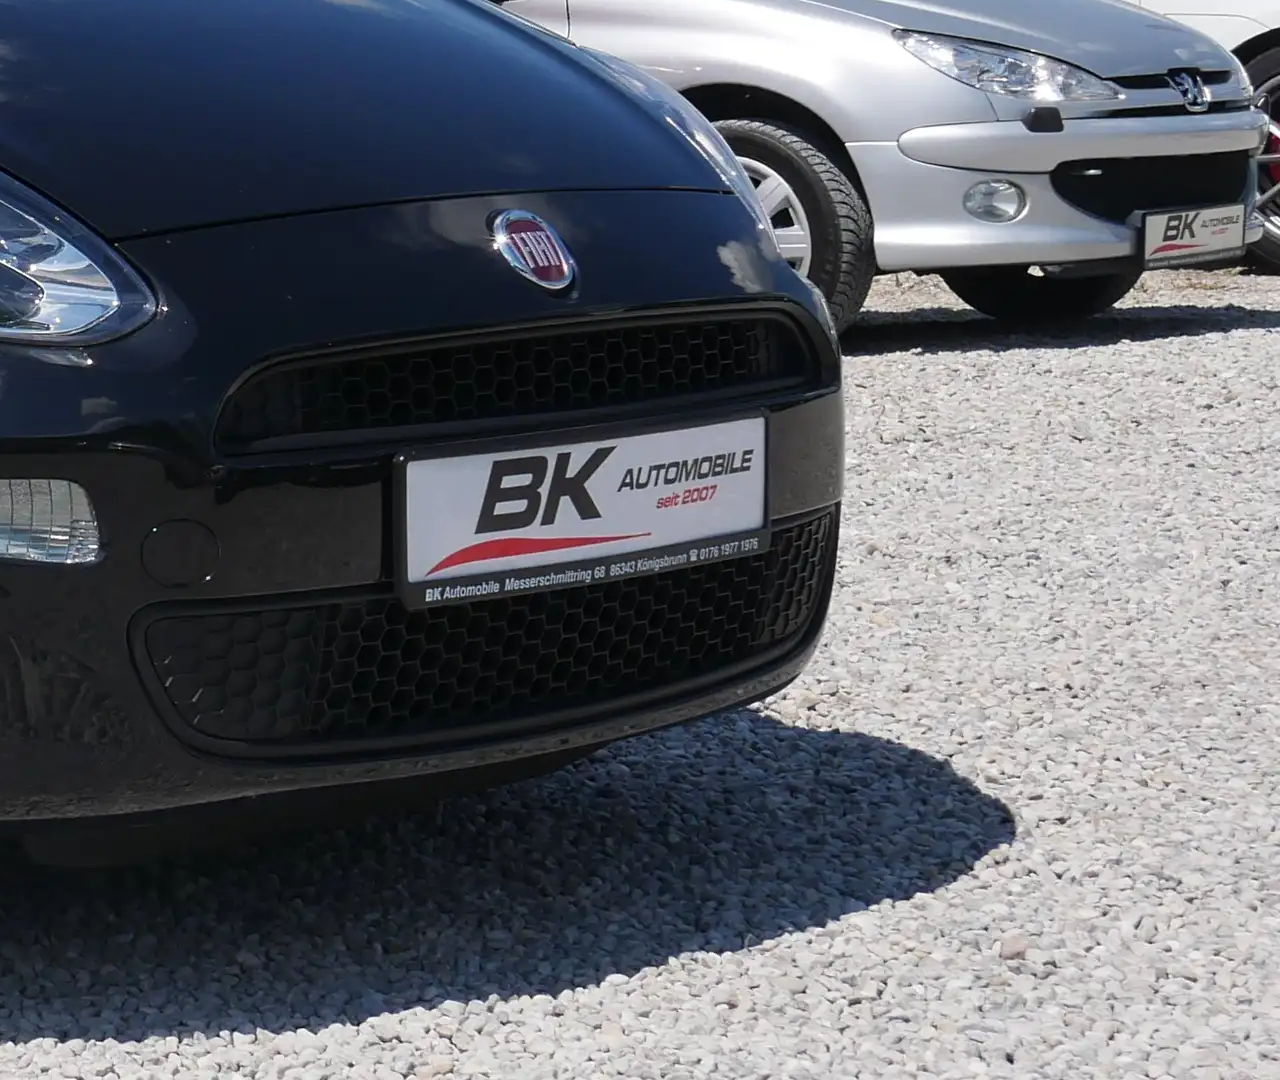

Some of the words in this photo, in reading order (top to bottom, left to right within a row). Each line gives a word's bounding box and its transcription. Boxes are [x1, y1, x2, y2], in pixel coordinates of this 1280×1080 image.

[1162, 212, 1200, 242] BK
[511, 231, 561, 268] FIAT
[474, 445, 618, 535] BK
[617, 449, 755, 493] AUTOMOBILE
[656, 491, 681, 509] seit
[681, 484, 718, 506] 2007
[425, 587, 443, 602] BK
[443, 581, 500, 599] Automobile
[504, 570, 592, 592] Messerschmittring
[594, 565, 606, 580] 68
[610, 560, 636, 576] 86343
[637, 553, 688, 572] Königsbrunn
[699, 546, 719, 560] 0176
[721, 541, 739, 556] 1977
[741, 537, 759, 552] 1976
